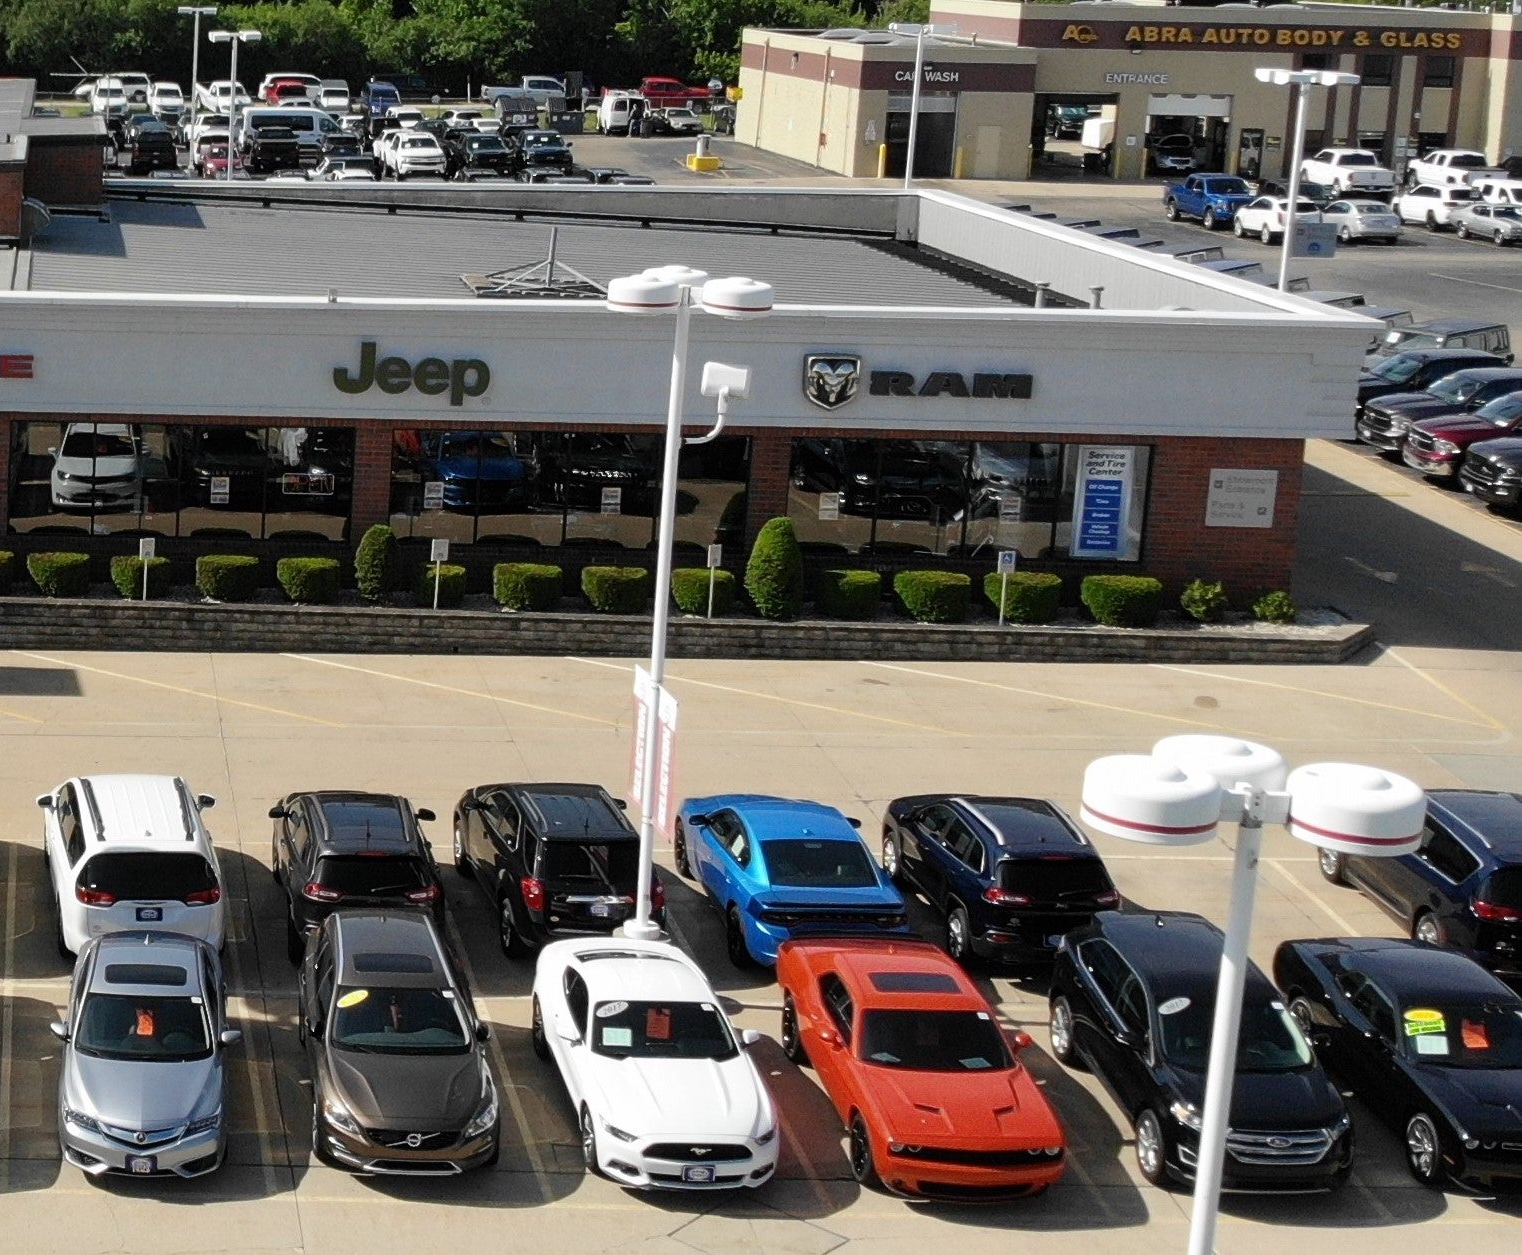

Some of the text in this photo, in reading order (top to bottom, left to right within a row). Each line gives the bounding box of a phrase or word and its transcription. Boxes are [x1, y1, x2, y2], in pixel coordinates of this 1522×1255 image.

[1125, 26, 1461, 48] ABRA AUTO BODY & GLASS
[924, 71, 959, 82] WASH
[1105, 73, 1170, 84] ENTRANCE
[332, 341, 490, 407] Jeep
[869, 370, 1033, 399] RAM
[1088, 450, 1126, 460] Service
[1086, 459, 1126, 468] and Tire
[1088, 467, 1123, 476] Center
